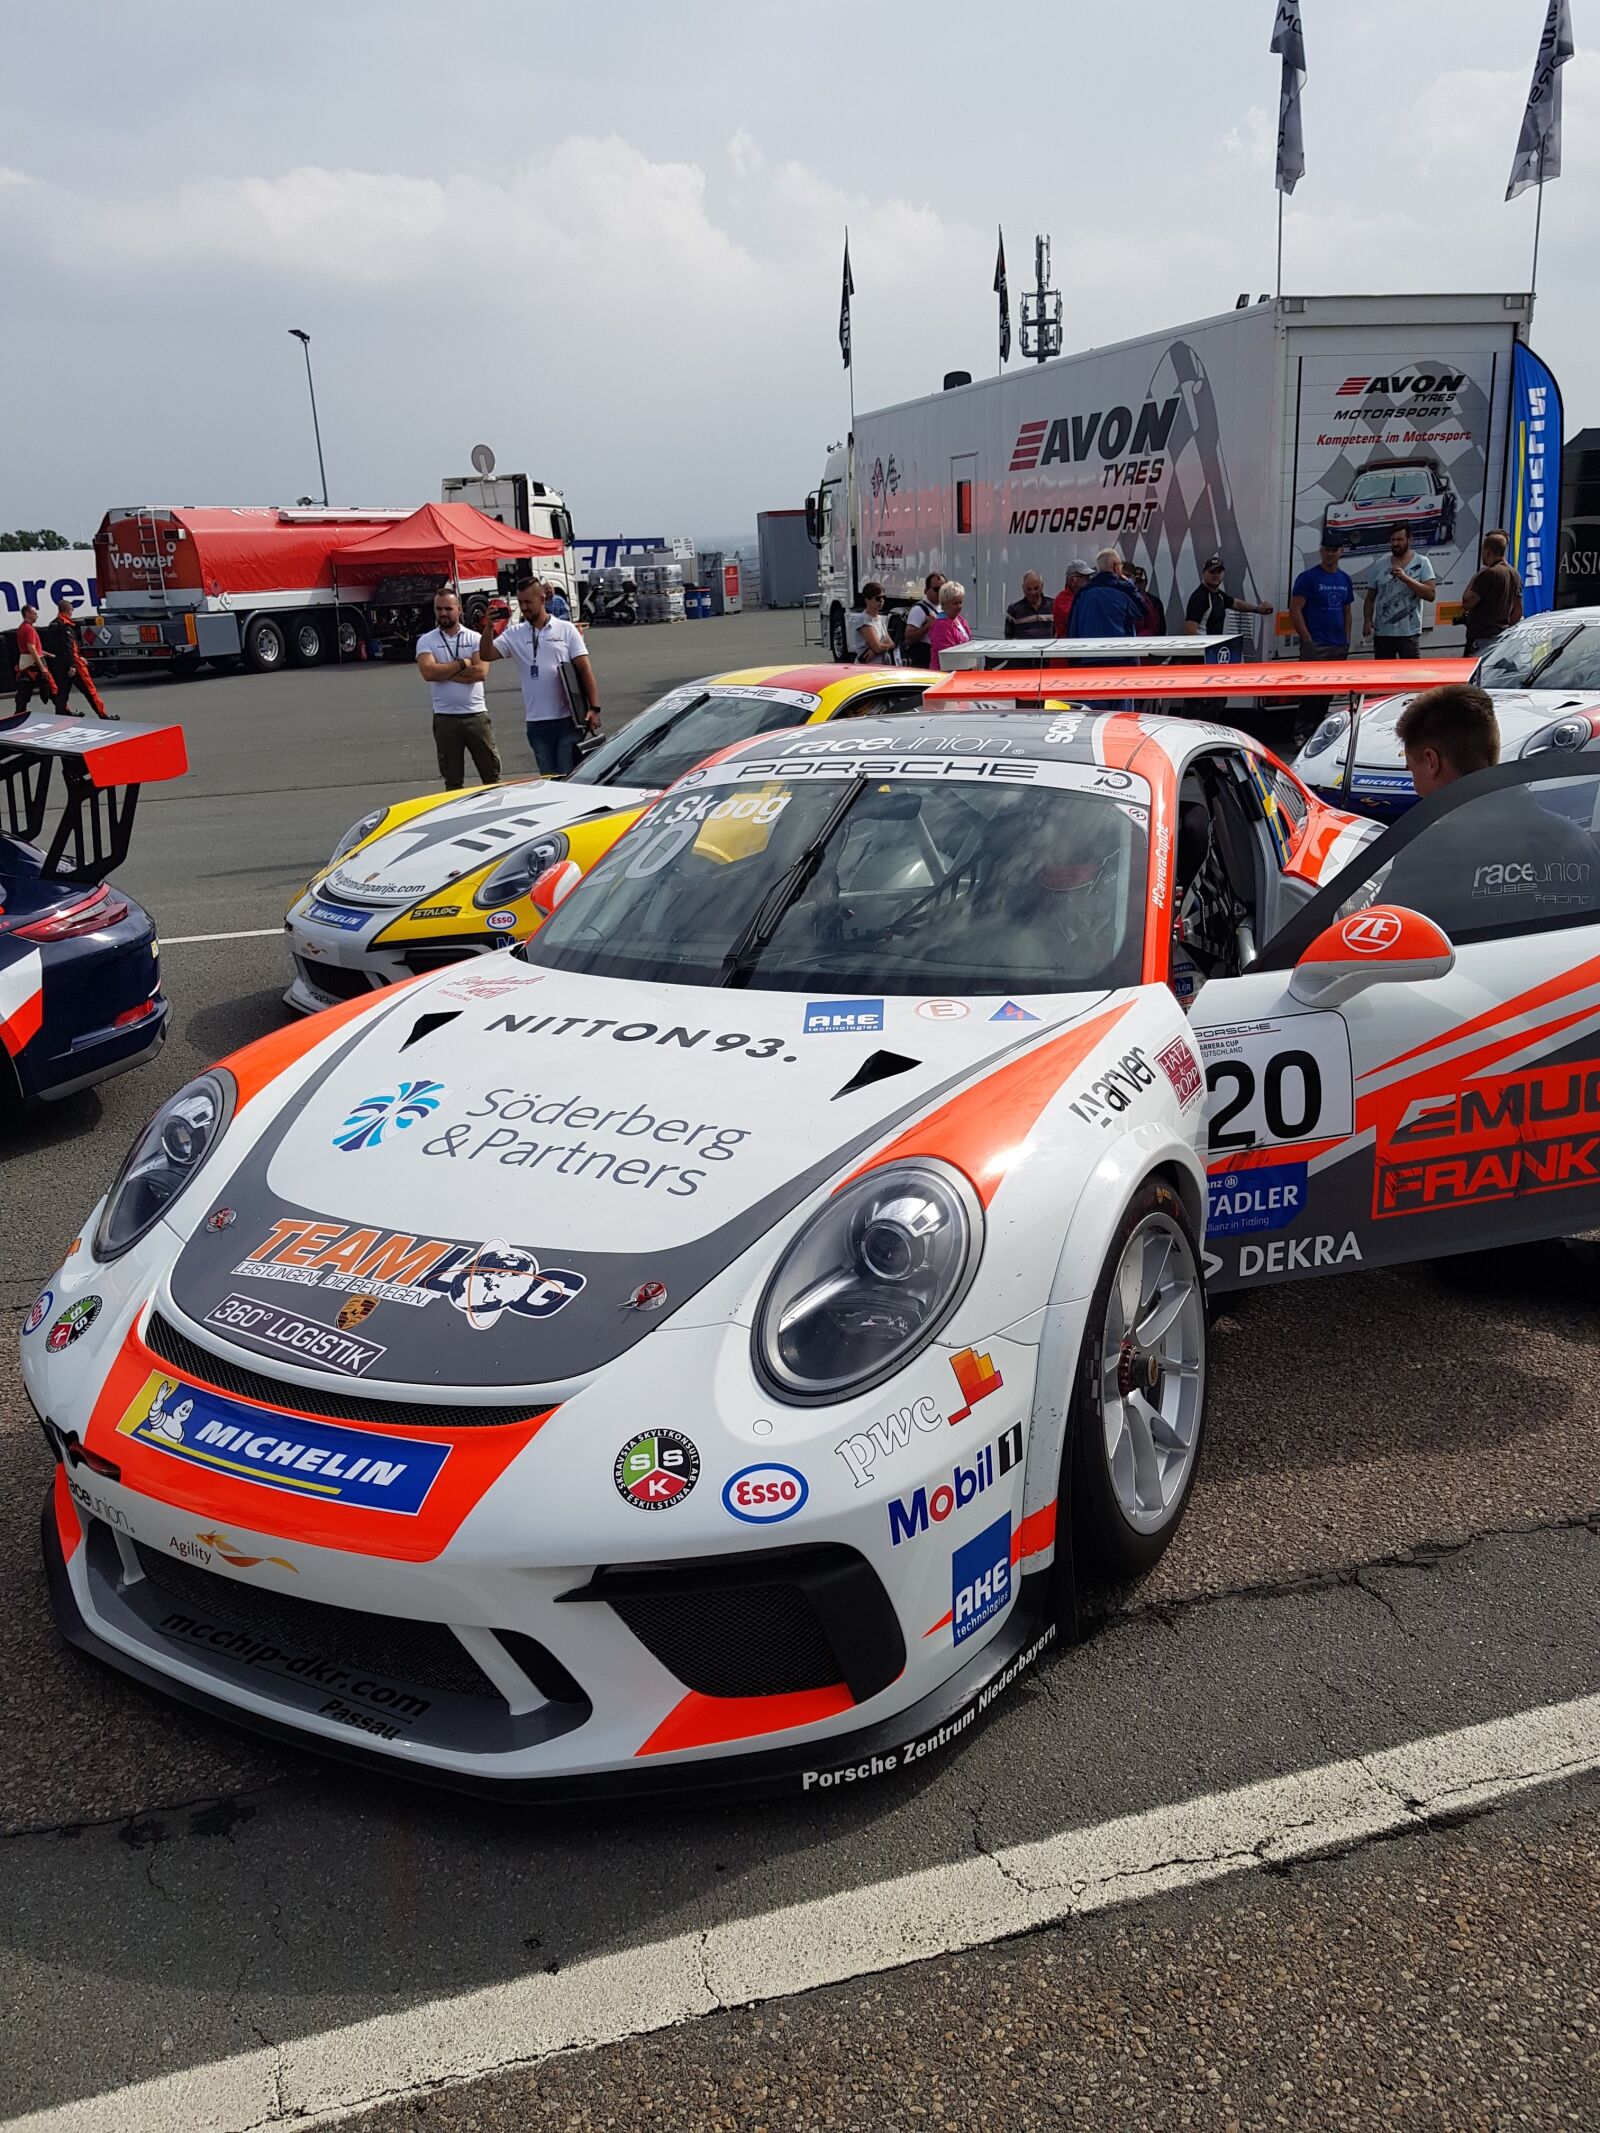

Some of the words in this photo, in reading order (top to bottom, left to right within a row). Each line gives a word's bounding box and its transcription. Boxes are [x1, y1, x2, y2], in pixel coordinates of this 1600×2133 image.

[1365, 375, 1465, 393] AVON
[1414, 392, 1456, 402] TYRES
[1040, 396, 1180, 465] AVON
[1333, 406, 1451, 420] MOTORSPORT
[1317, 433, 1382, 446] Kompetenz
[1385, 431, 1399, 443] im
[1403, 430, 1473, 443] Motorsport
[1103, 457, 1165, 488] TYRES
[1525, 387, 1547, 587] MICHELIN
[1009, 501, 1159, 535] MOTORSPORT
[110, 553, 174, 569] V-Power
[1558, 551, 1600, 575] ASSI
[966, 677, 1176, 692] Sparbanken
[737, 761, 1039, 779] PORSCHE
[631, 793, 793, 832] H.Skoog
[578, 820, 699, 891] 20
[1151, 821, 1171, 910] #CarreraCupDE
[1473, 855, 1590, 887] raceunion
[315, 908, 360, 925] MICHELIN
[413, 906, 458, 918] STALOC
[1347, 917, 1399, 946] ZF
[485, 1013, 708, 1053] NITTON
[710, 1033, 798, 1063] 93.
[808, 1014, 879, 1027] AKE
[1194, 1022, 1271, 1038] PORSCHE
[1159, 1041, 1190, 1076] HATZ
[1199, 1042, 1226, 1051] ARRERA
[1226, 1040, 1239, 1048] CUP
[1201, 1046, 1243, 1058] EUTSCHLAND
[1174, 1066, 1199, 1102] POPP
[1207, 1049, 1322, 1149] 20
[465, 1088, 752, 1161] Söderberg
[421, 1124, 471, 1158] &
[468, 1128, 710, 1196] Partners
[1207, 1184, 1299, 1218] TADLER
[1230, 1220, 1239, 1229] in
[1241, 1215, 1270, 1228] Tittling
[1239, 1230, 1363, 1278] DEKRA
[232, 1261, 319, 1286] LEISTUNGEN,
[322, 1275, 347, 1289] DIE
[347, 1278, 430, 1306] BEWEGEN.
[213, 1299, 274, 1327] 360°
[264, 1316, 375, 1371] LOGISTIK
[194, 1421, 408, 1486] MICHELIN
[615, 1440, 637, 1489] SKRAVSTA
[637, 1429, 699, 1465] SKYLTKONSULT
[689, 1468, 699, 1482] AB
[834, 1396, 943, 1489] pwc
[626, 1486, 691, 1511] ESKILSTUNA
[886, 1442, 993, 1547] Mobil
[170, 1536, 212, 1565] Agility
[955, 1557, 1008, 1625] AKE
[956, 1590, 1009, 1638] technologies
[159, 1612, 432, 1718] mcchip-dkr.com
[318, 1700, 402, 1741] Passau
[802, 1753, 898, 1791] Porsche
[903, 1707, 975, 1765] Zentrum
[978, 1622, 1057, 1714] Niederbayern
